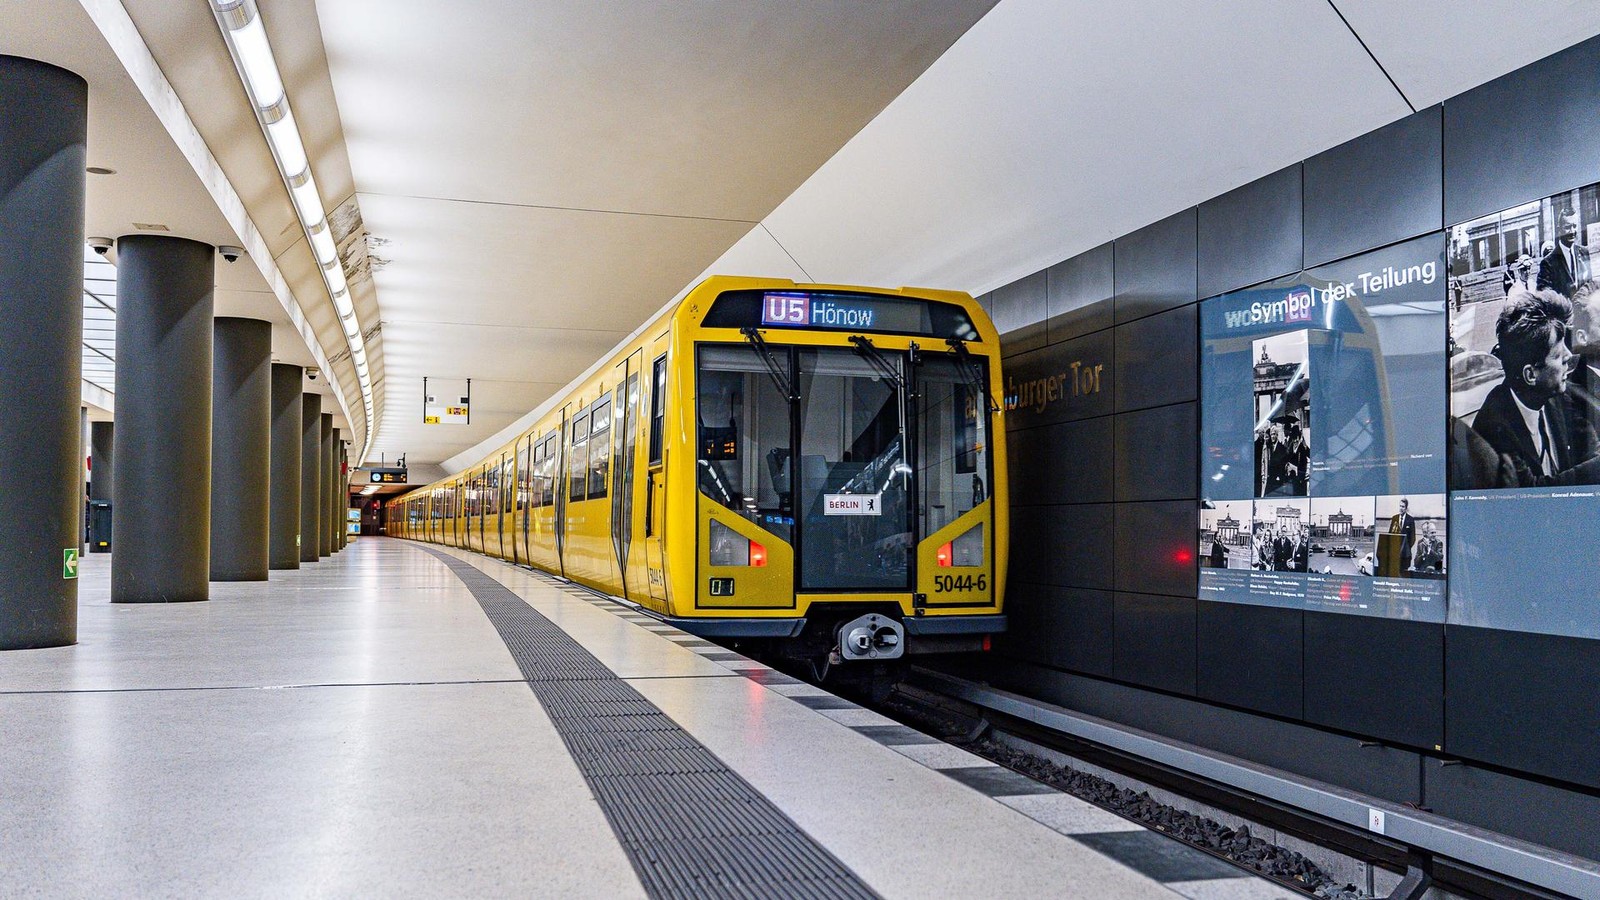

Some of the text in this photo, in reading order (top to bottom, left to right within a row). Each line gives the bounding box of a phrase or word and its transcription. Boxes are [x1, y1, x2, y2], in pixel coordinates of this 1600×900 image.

[1251, 287, 1315, 323] Symbol
[1321, 282, 1355, 304] der
[1358, 261, 1436, 295] Teilung
[770, 298, 873, 326] U5 Hönow
[1070, 361, 1103, 396] Tor
[829, 501, 859, 509] BERLIN
[934, 573, 987, 593] 5044-6
